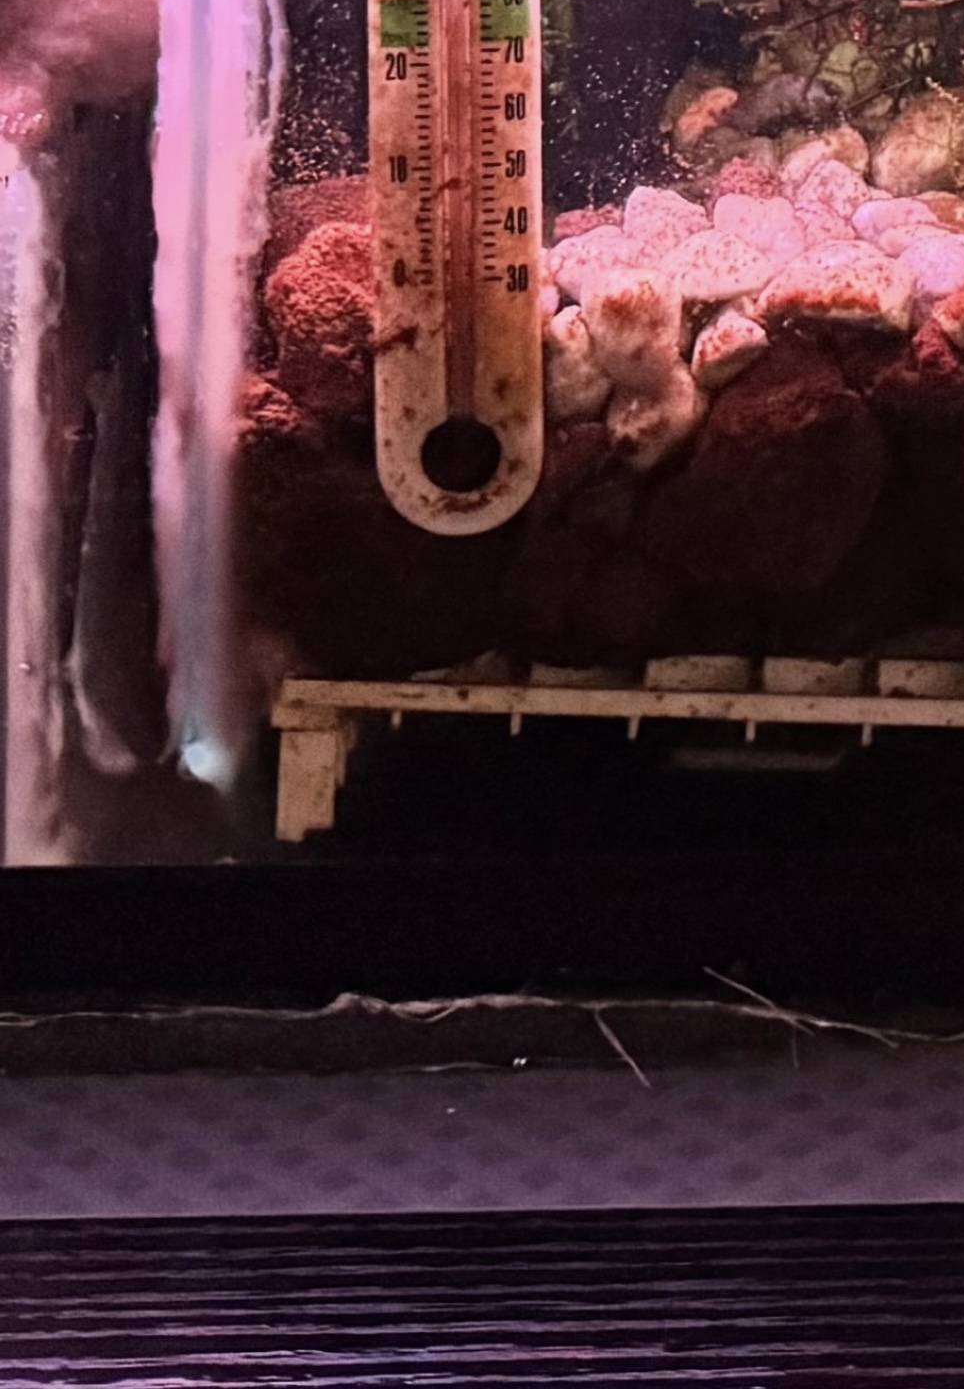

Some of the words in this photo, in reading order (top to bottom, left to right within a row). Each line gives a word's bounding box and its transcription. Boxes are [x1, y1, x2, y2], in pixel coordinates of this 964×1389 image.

[504, 35, 524, 63] 70
[385, 52, 407, 80] 20
[505, 93, 526, 120] 60
[389, 155, 407, 183] 10
[505, 149, 526, 178] 50
[504, 207, 527, 235] 40
[393, 258, 407, 288] 0
[507, 264, 528, 292] 30
